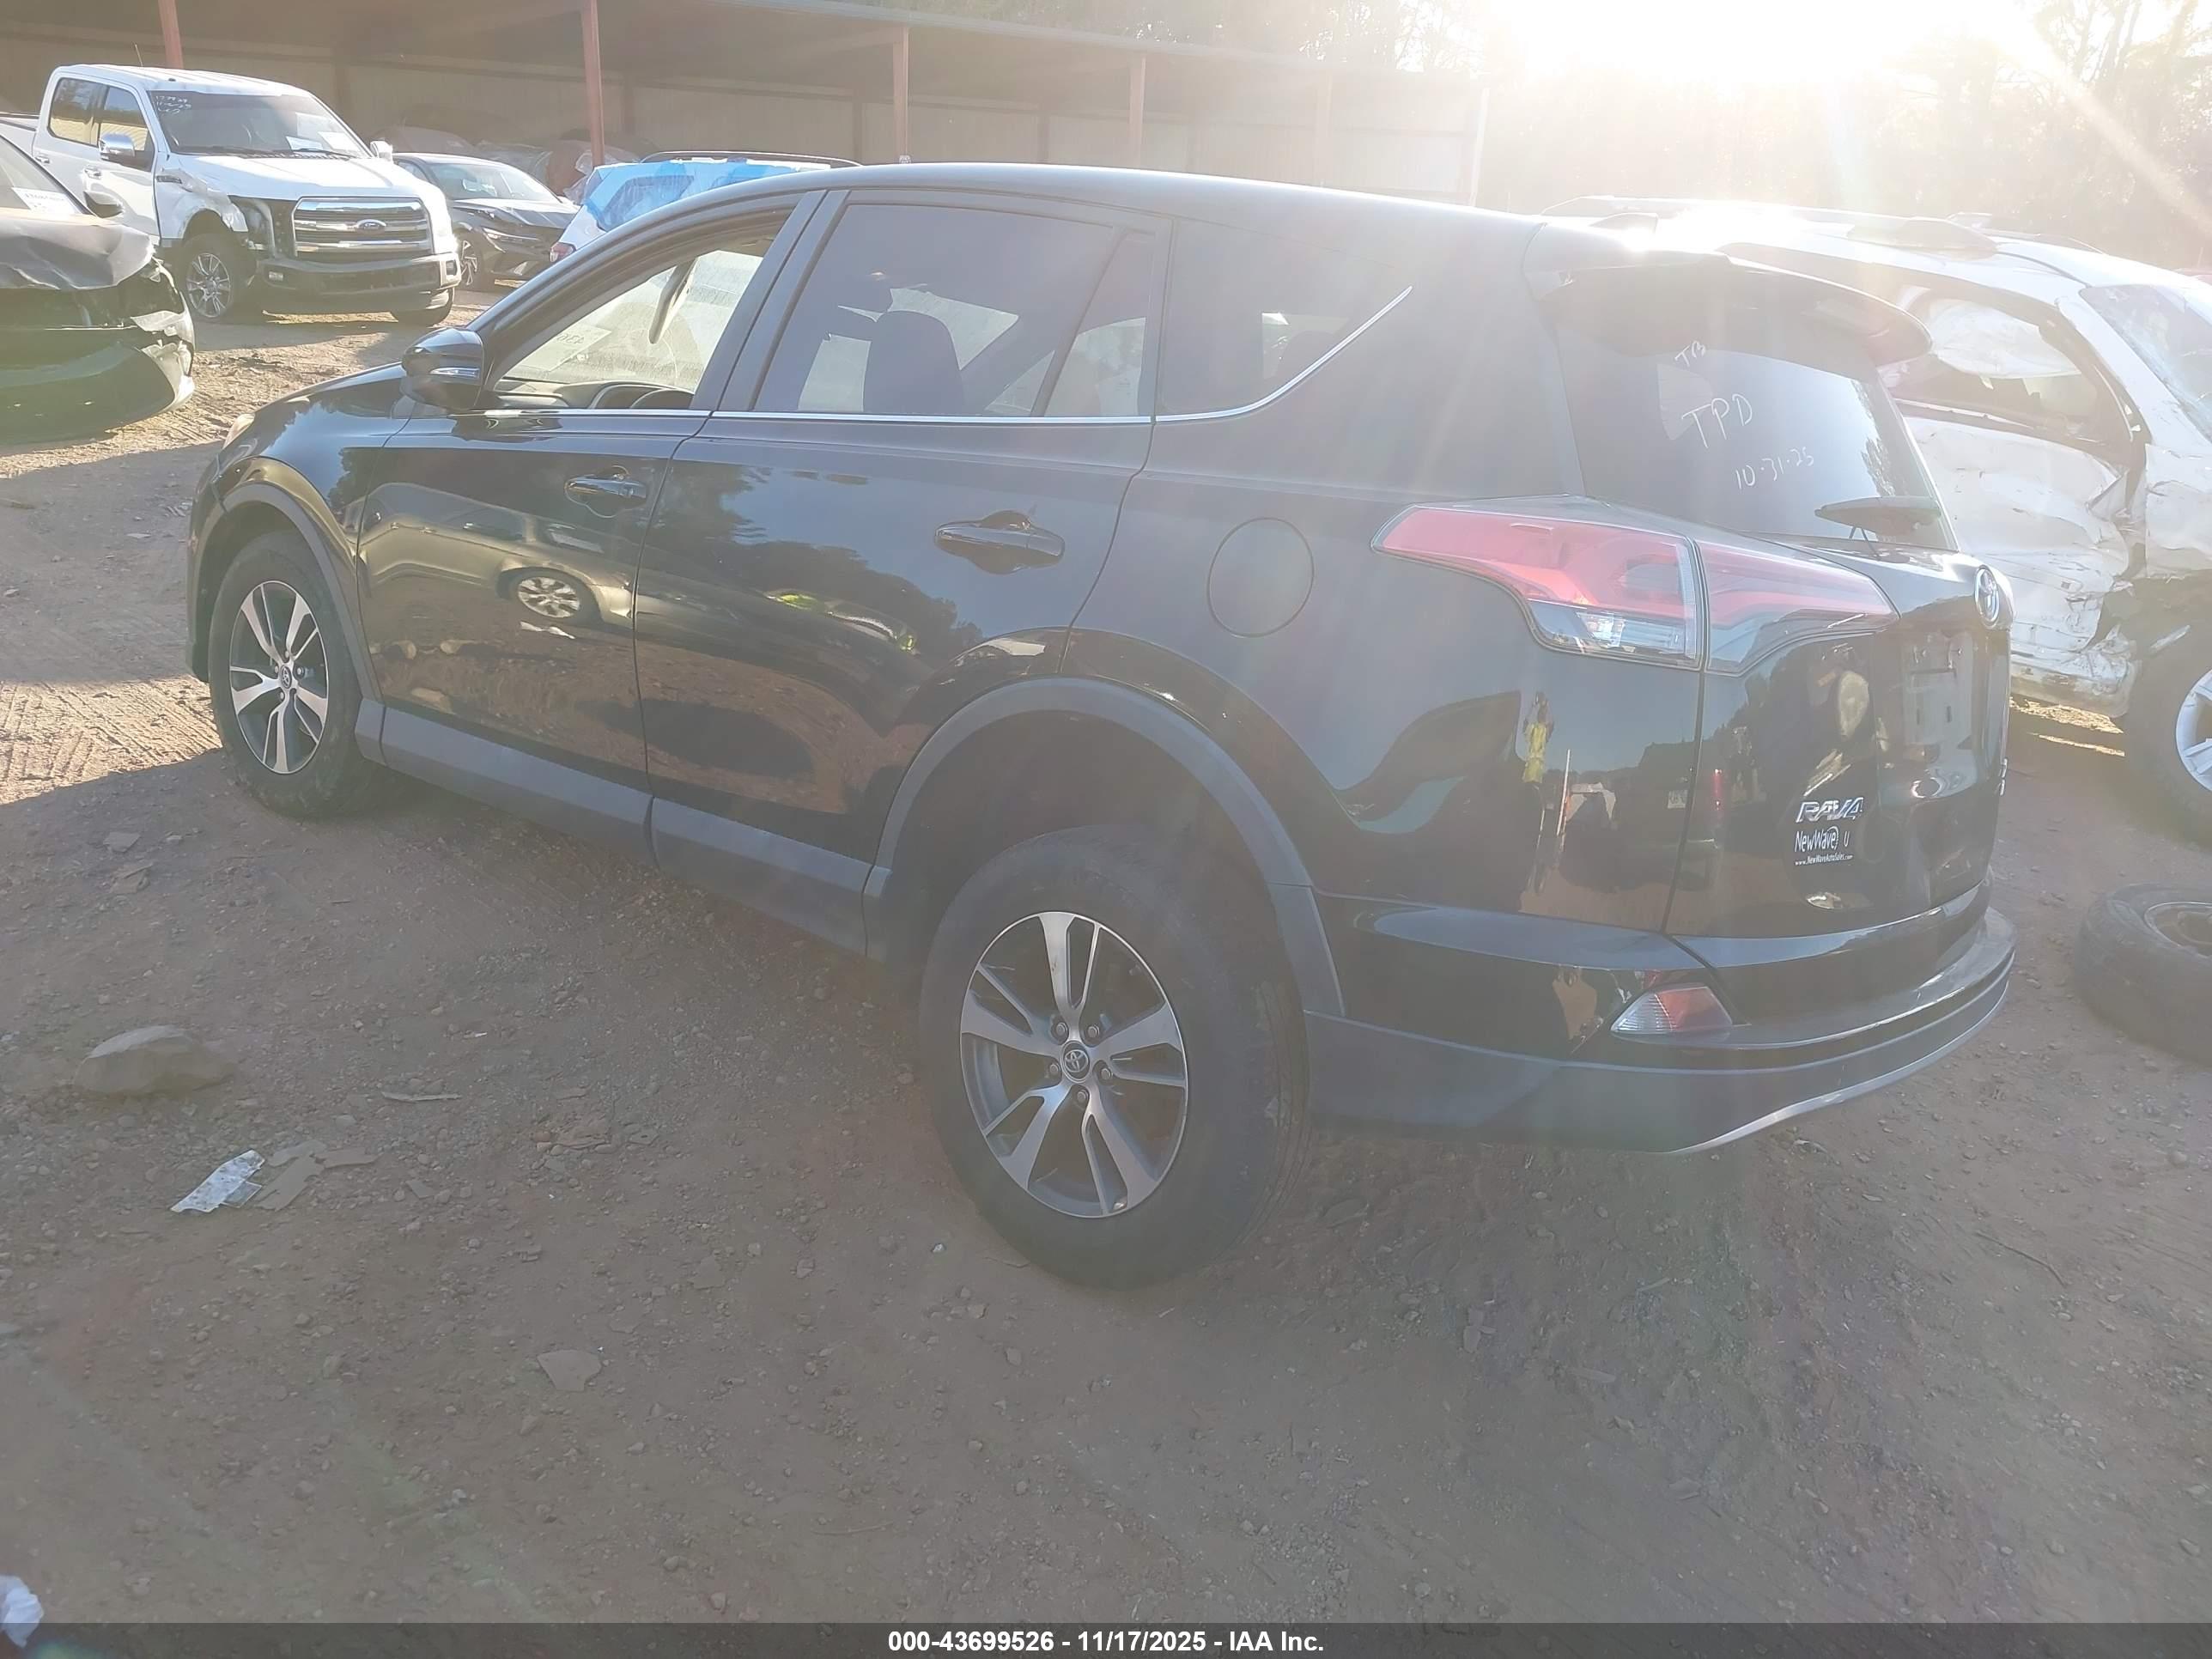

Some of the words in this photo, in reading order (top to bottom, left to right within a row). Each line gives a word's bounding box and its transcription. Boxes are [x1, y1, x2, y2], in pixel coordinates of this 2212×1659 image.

[1681, 393, 1753, 448] TPD
[1796, 797, 1863, 823] RAV4
[1795, 828, 1838, 853] NewWave
